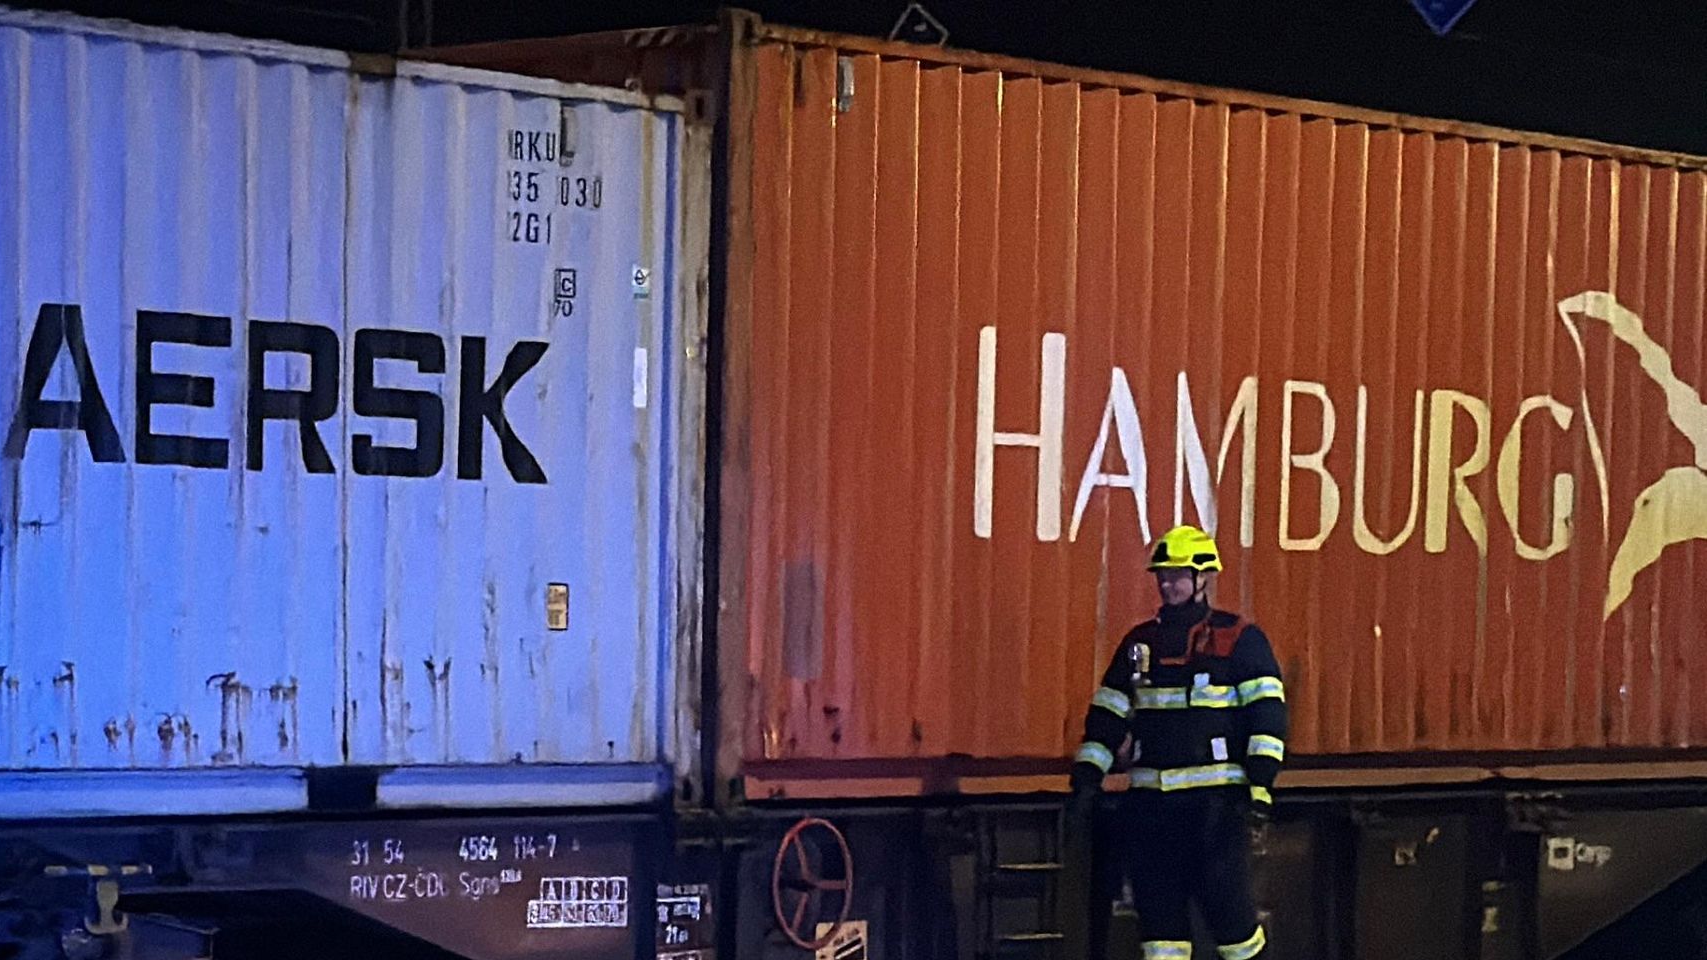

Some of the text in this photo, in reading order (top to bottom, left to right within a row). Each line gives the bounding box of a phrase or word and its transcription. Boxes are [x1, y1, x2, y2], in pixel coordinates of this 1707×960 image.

[507, 129, 556, 162] RKU
[507, 211, 552, 245] 2G1
[974, 325, 1574, 561] HAMBURG
[350, 839, 370, 866] 31
[383, 838, 405, 865] 54
[458, 834, 498, 861] 4564
[350, 874, 379, 899] RIV
